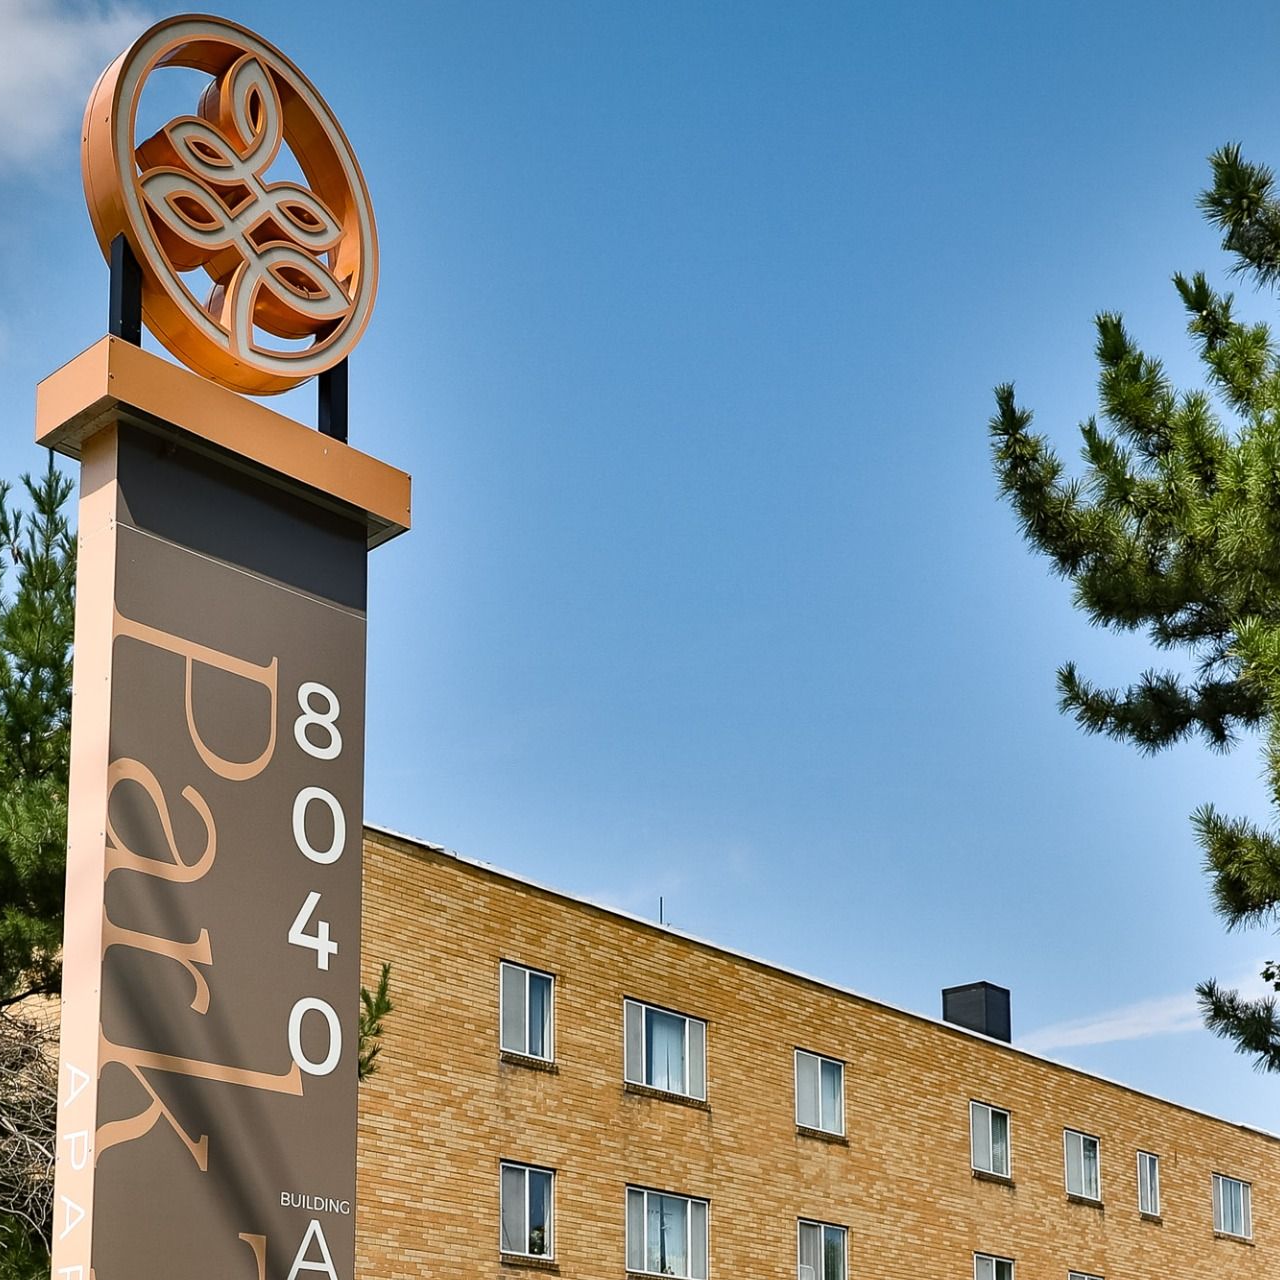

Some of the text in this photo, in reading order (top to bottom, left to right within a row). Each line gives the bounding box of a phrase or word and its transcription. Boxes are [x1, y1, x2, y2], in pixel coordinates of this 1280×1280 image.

[95, 600, 304, 1172] Park
[287, 682, 346, 1076] 8040
[280, 1191, 350, 1215] BUILDING
